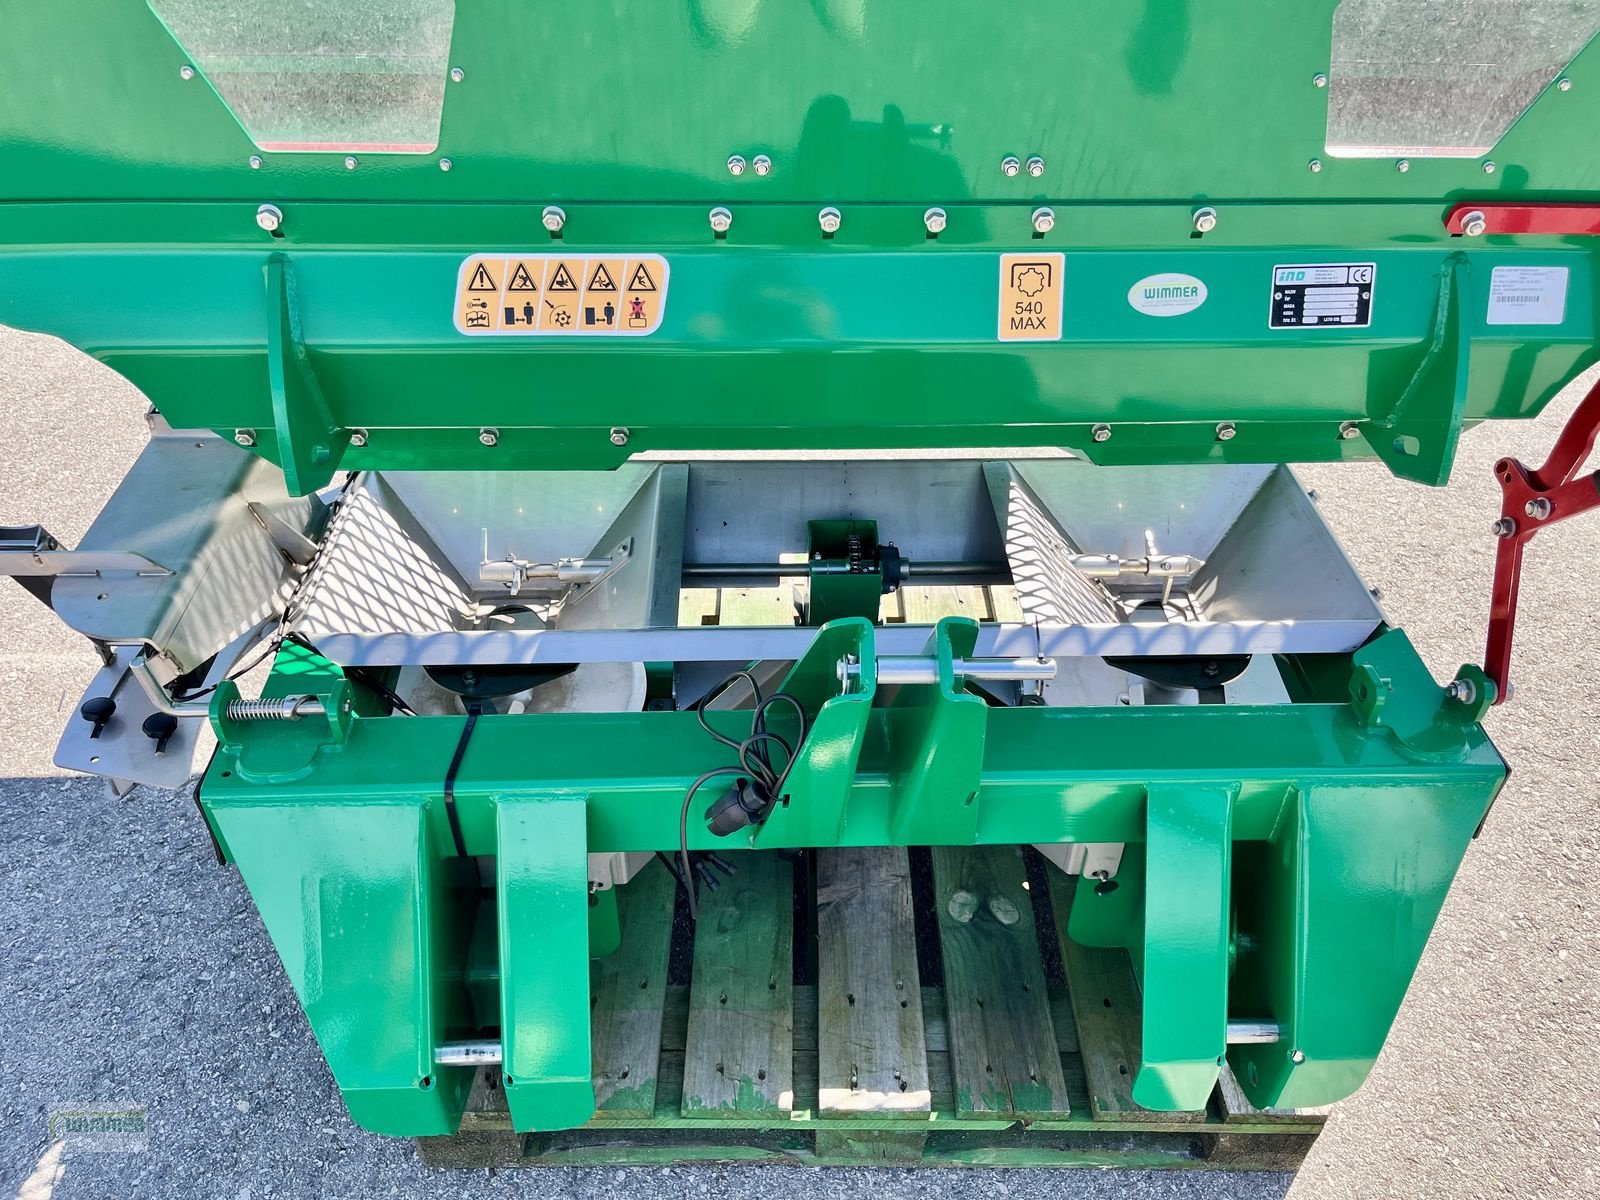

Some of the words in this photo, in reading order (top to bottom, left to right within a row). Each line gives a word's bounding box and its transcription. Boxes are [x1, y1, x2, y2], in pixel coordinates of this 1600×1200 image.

[1144, 286, 1198, 299] WIMMER
[1015, 301, 1043, 315] 540
[1010, 316, 1046, 330] MAX
